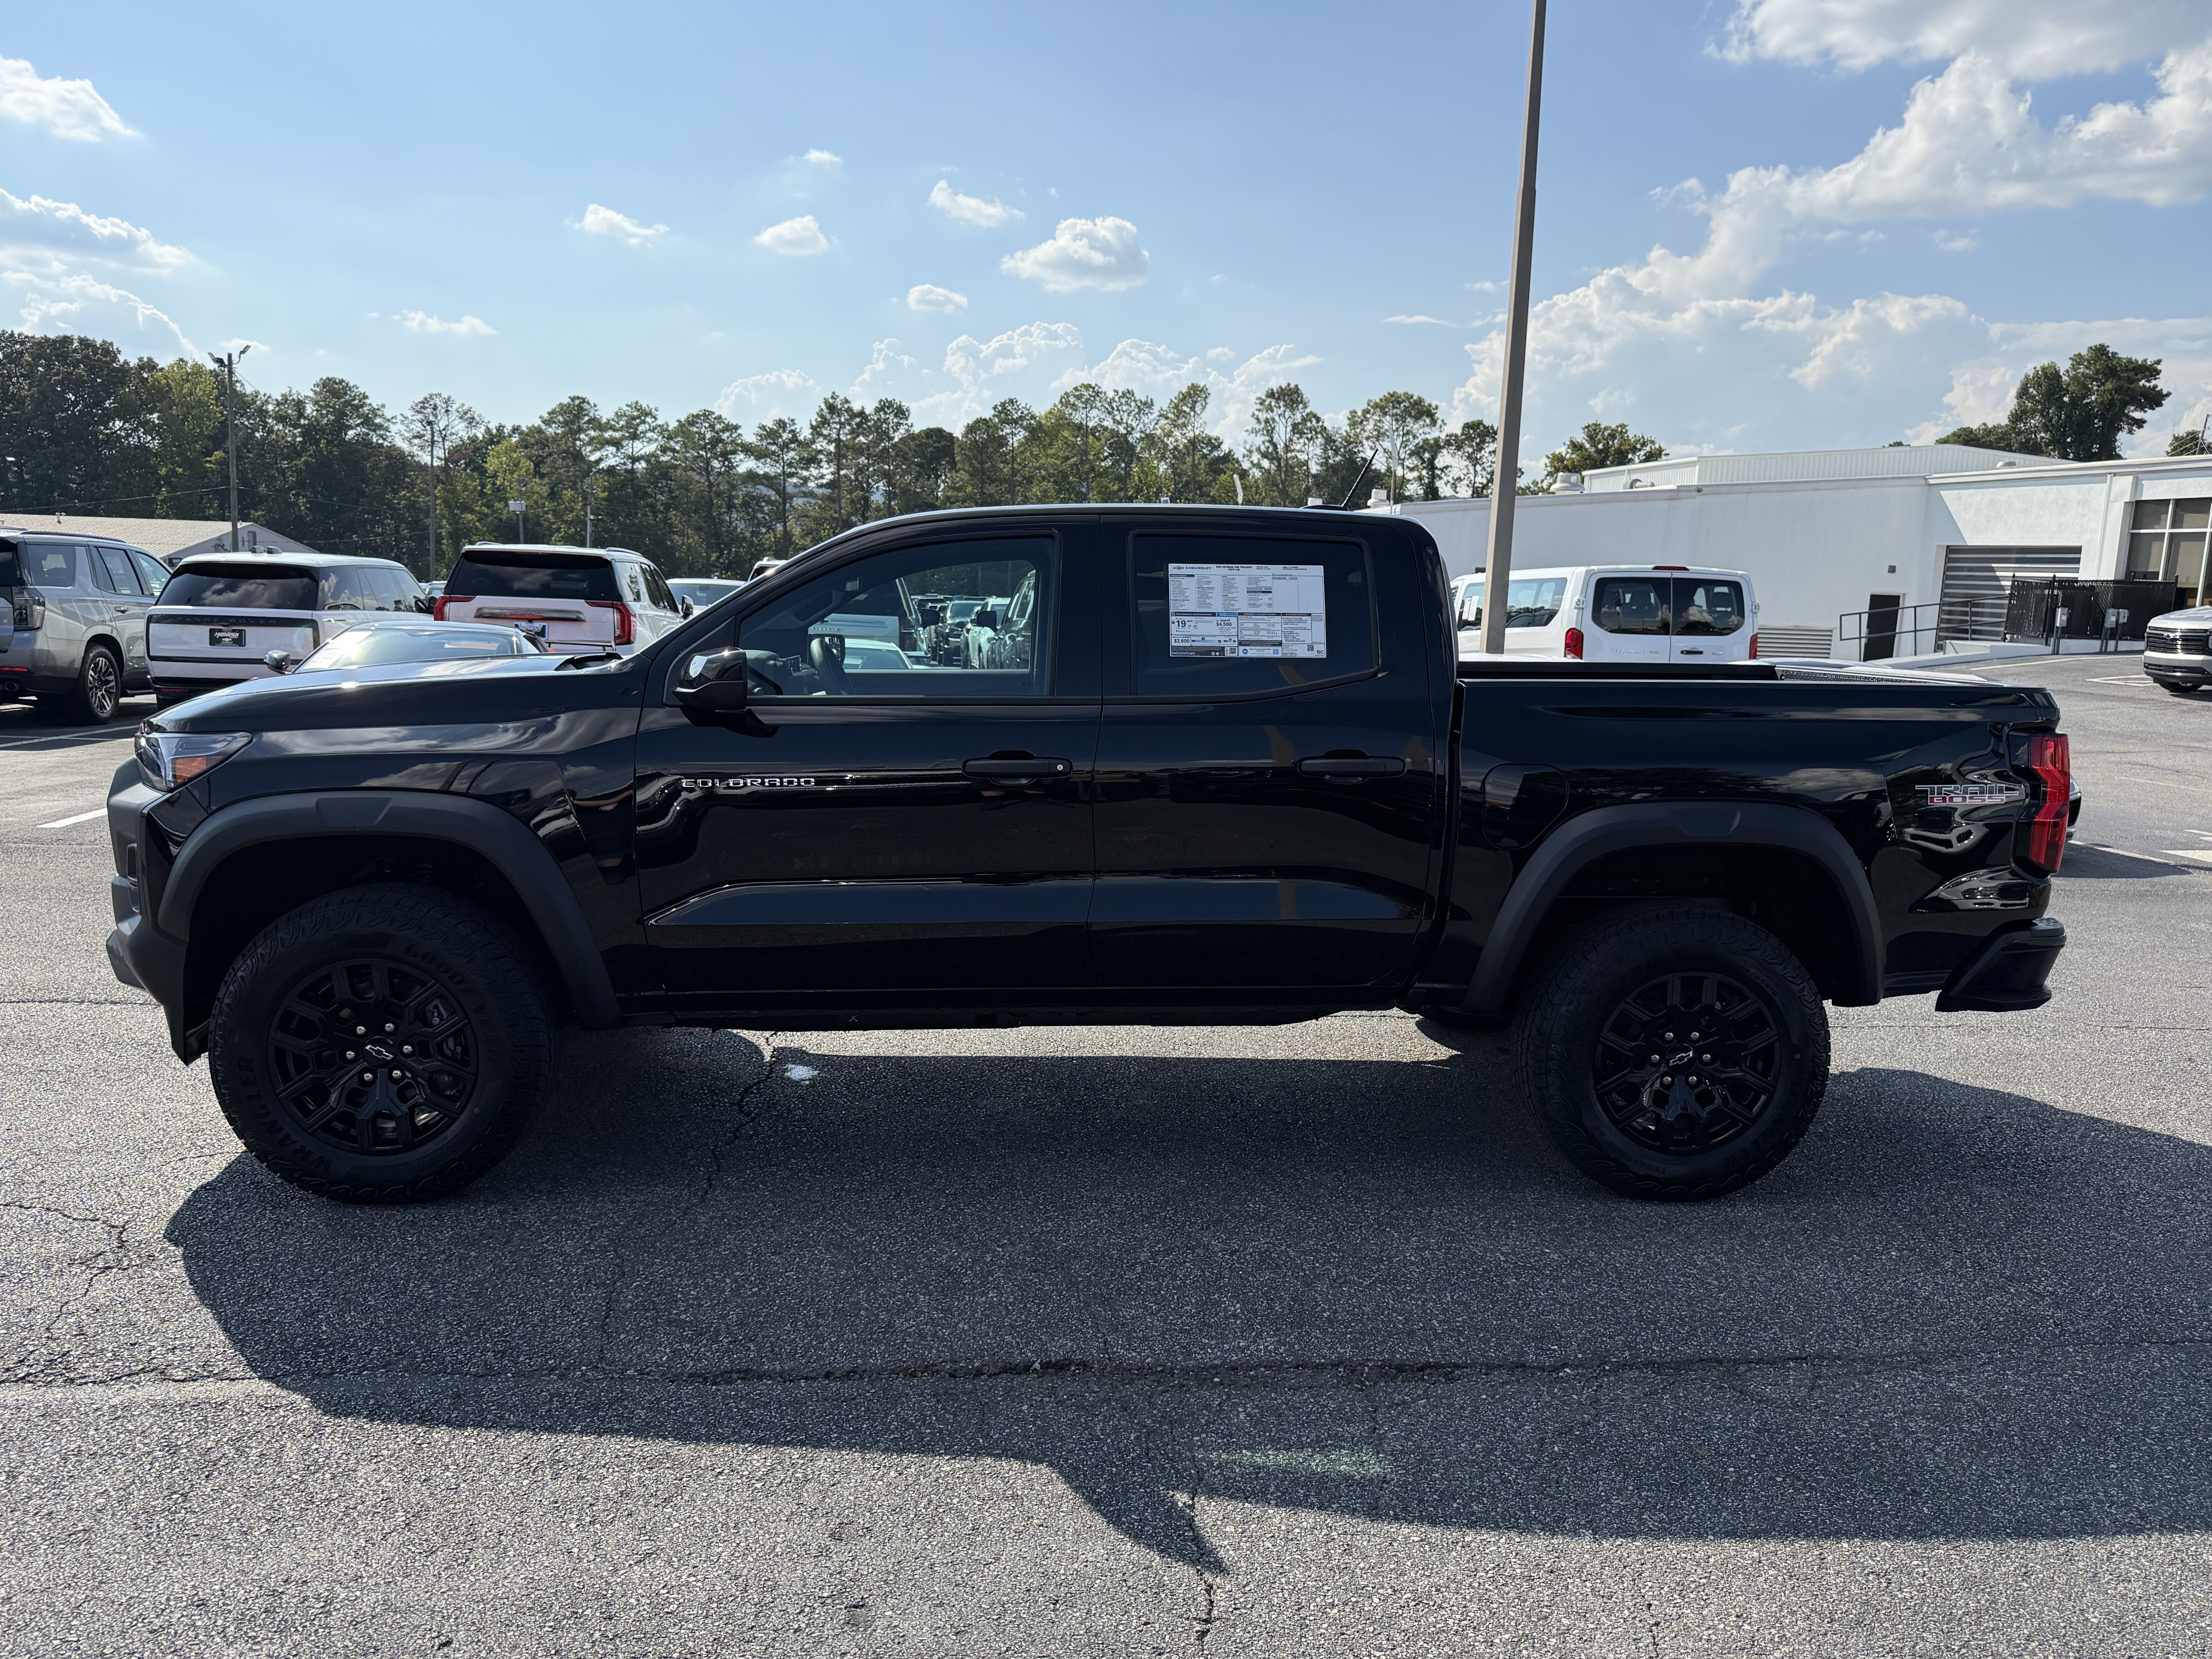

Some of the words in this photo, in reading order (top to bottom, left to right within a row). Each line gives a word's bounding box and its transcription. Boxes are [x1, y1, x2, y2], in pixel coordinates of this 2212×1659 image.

[681, 778, 815, 787] COLORADO
[1915, 785, 2019, 796] TRAIL
[1928, 796, 2006, 805] BOSS
[237, 1056, 333, 1174] WRANGLER
